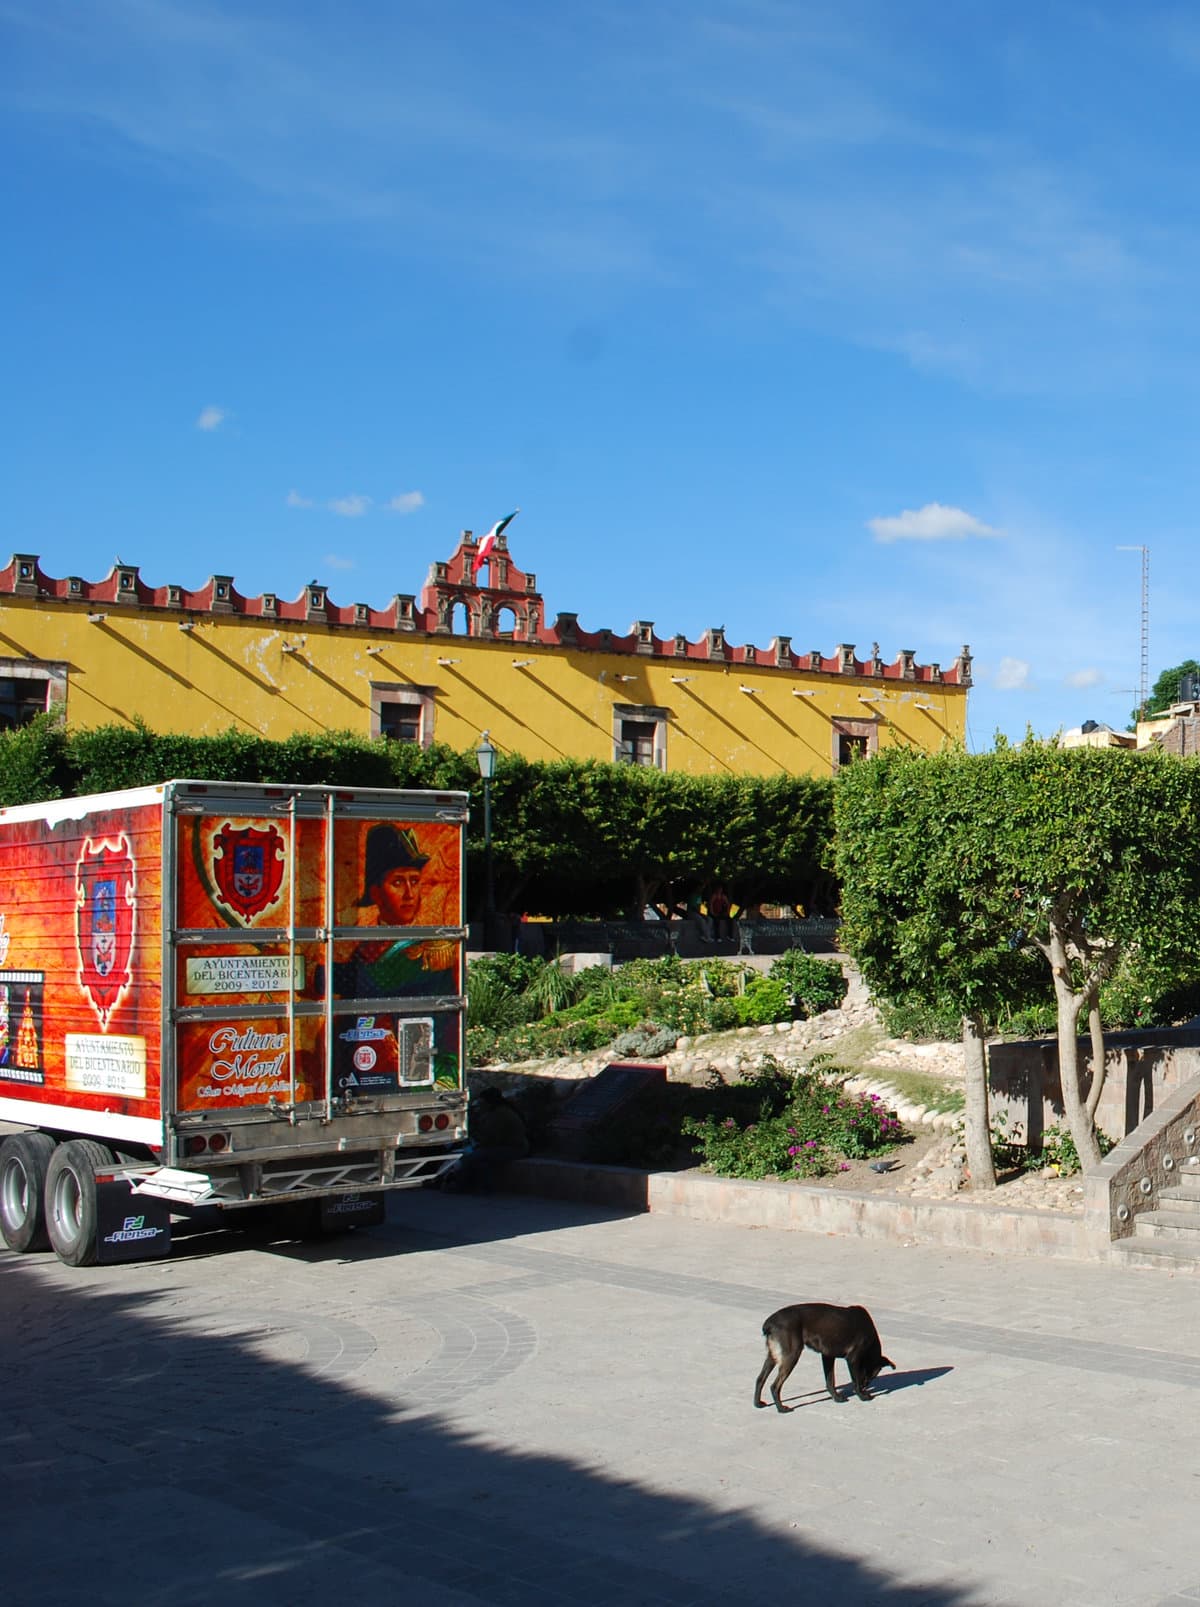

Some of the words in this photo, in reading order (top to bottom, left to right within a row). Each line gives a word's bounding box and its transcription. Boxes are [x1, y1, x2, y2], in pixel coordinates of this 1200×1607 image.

[203, 958, 290, 970] AYUNTAMIENTO
[194, 970, 216, 981] DEL
[214, 980, 242, 990] 2009
[252, 979, 279, 989] 2012
[76, 1038, 134, 1056] AYUNTAMIENTO
[209, 1026, 287, 1053] Cultura
[70, 1056, 83, 1069] DEL
[85, 1057, 140, 1074] BICENTENARIO
